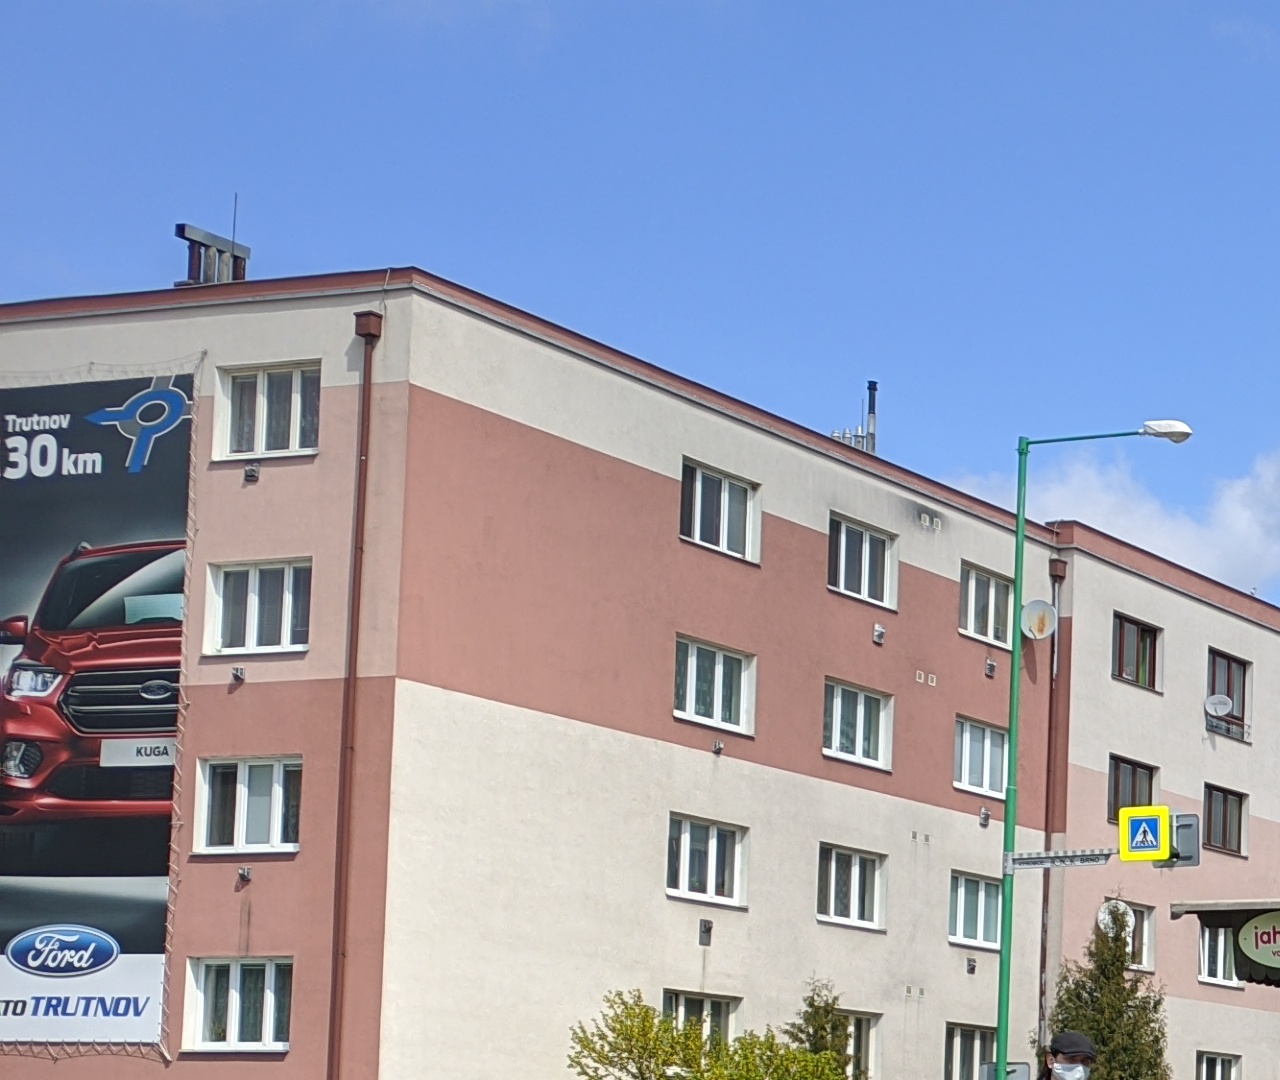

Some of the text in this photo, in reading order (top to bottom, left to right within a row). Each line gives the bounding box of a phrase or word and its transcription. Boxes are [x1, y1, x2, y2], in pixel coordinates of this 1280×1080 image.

[5, 413, 71, 433] Trutnov
[3, 433, 103, 480] 30 km
[135, 746, 170, 757] KUGA
[27, 933, 98, 968] Ford
[0, 996, 151, 1018] TO TRUTNOV
